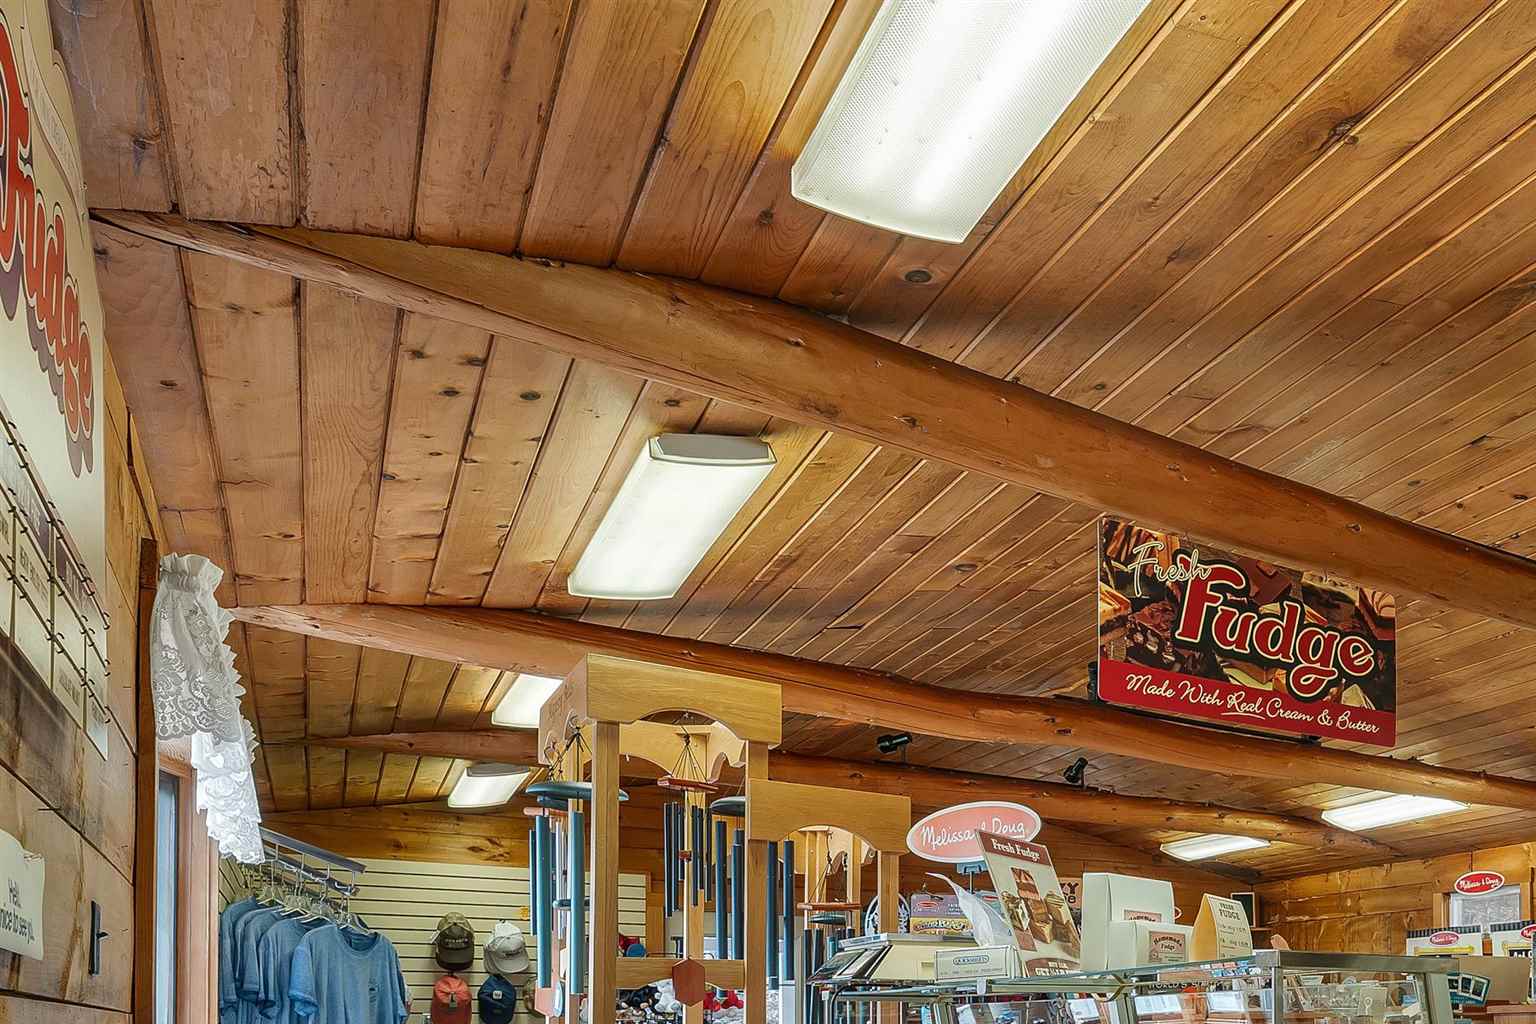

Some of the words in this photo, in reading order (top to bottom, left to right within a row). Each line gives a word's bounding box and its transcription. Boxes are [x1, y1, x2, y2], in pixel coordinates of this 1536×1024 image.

[1128, 541, 1211, 597] Fresh
[1175, 553, 1376, 698] Fudge
[1126, 673, 1176, 698] Made
[1178, 680, 1225, 706] With
[1227, 692, 1264, 714] Real
[1266, 698, 1314, 723] Cream
[1317, 710, 1334, 726] &
[1336, 712, 1380, 734] Butter
[922, 826, 975, 851] Melissa
[992, 817, 1026, 839] Doug
[990, 838, 1015, 854] Fresh
[1016, 844, 1040, 862] Fudge
[1219, 908, 1241, 920] FUDGE
